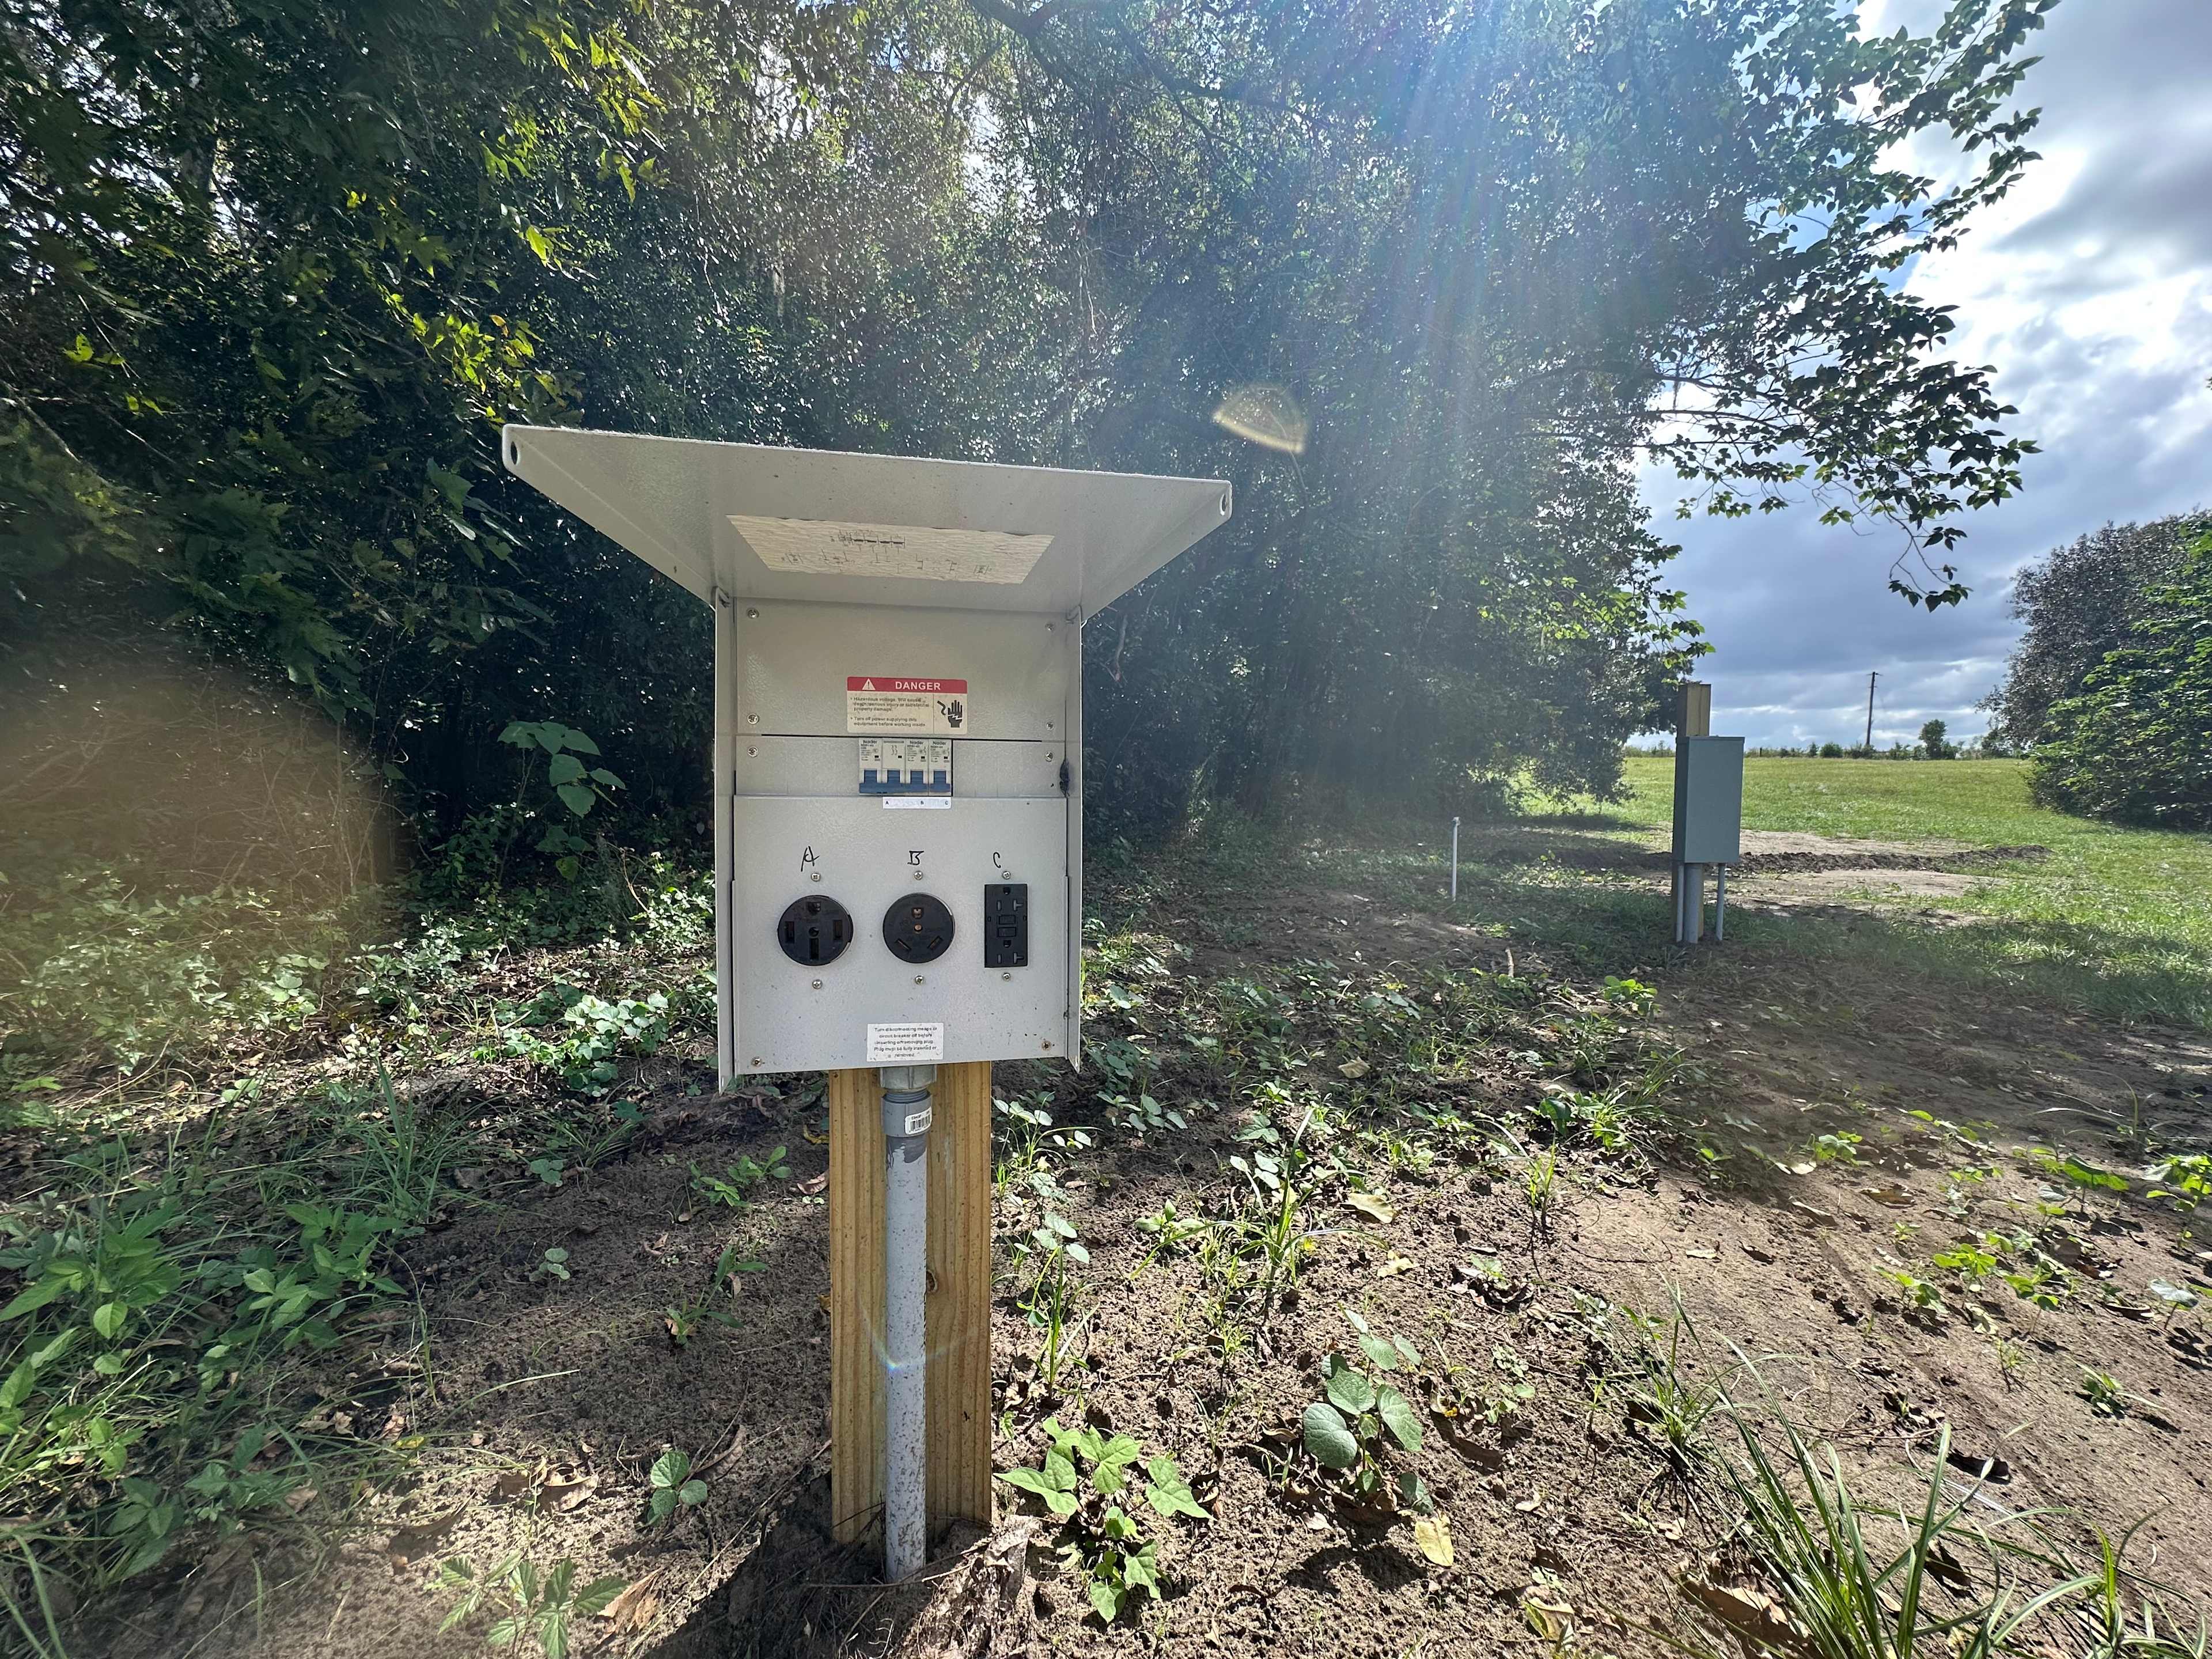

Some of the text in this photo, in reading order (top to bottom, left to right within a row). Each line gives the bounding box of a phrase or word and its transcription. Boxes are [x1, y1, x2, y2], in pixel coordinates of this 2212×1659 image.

[895, 681, 941, 691] DANGER
[801, 846, 820, 872] A
[907, 850, 925, 866] B
